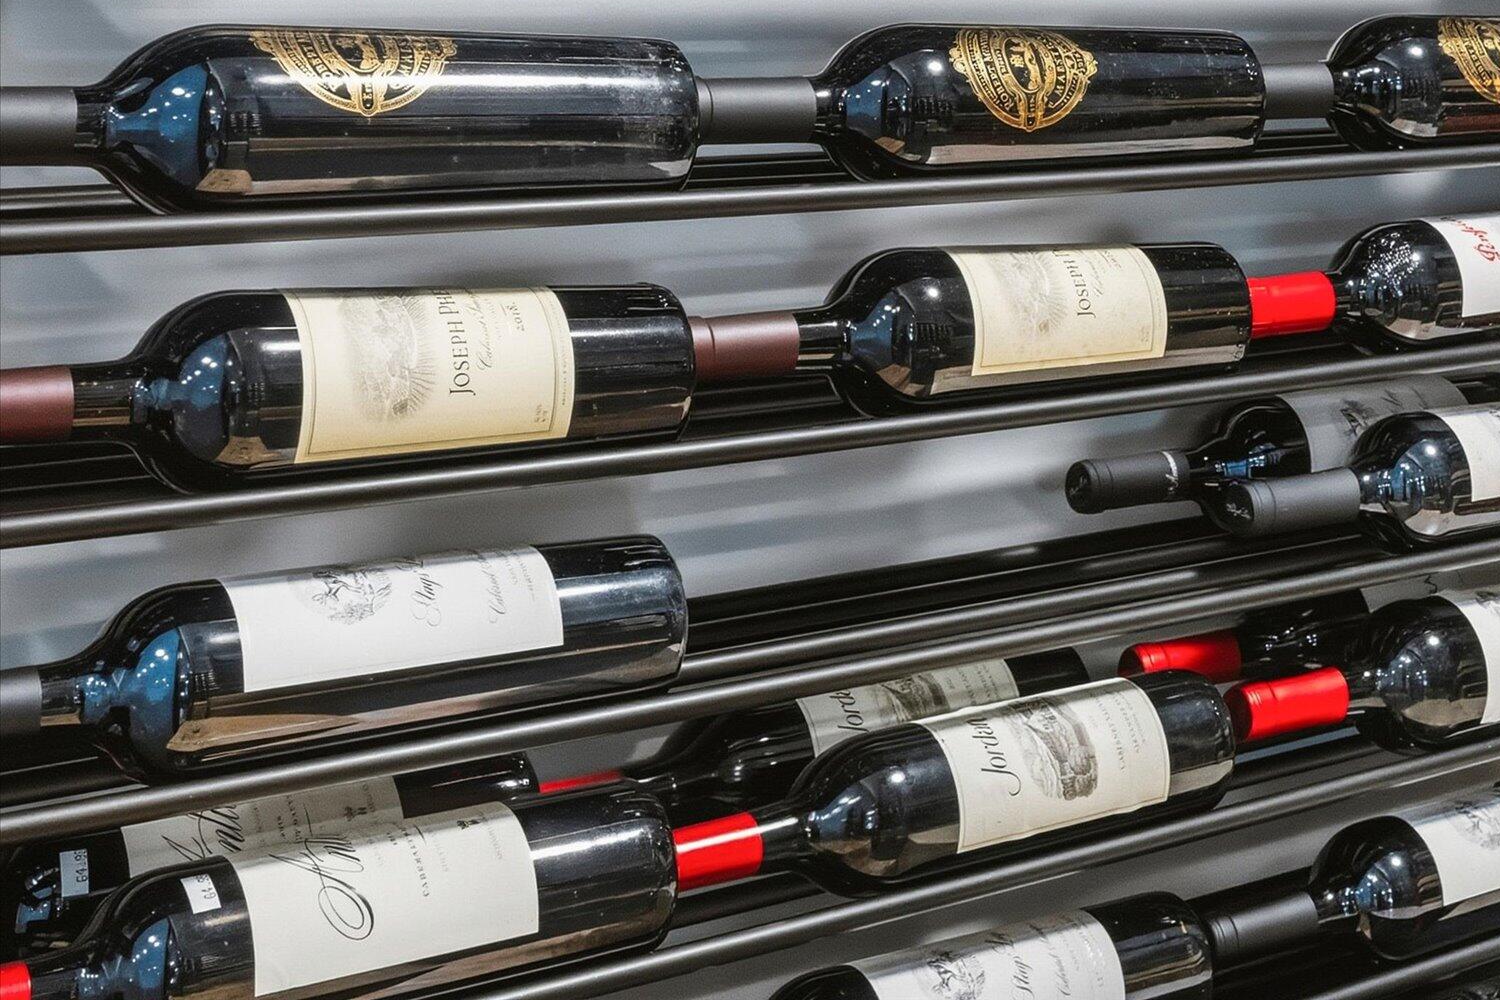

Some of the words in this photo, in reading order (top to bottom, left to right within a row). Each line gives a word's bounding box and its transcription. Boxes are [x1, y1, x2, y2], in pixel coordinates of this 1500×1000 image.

[1062, 258, 1096, 319] JOSEPH
[447, 321, 476, 397] JOSEPH
[966, 716, 1022, 797] Jordan
